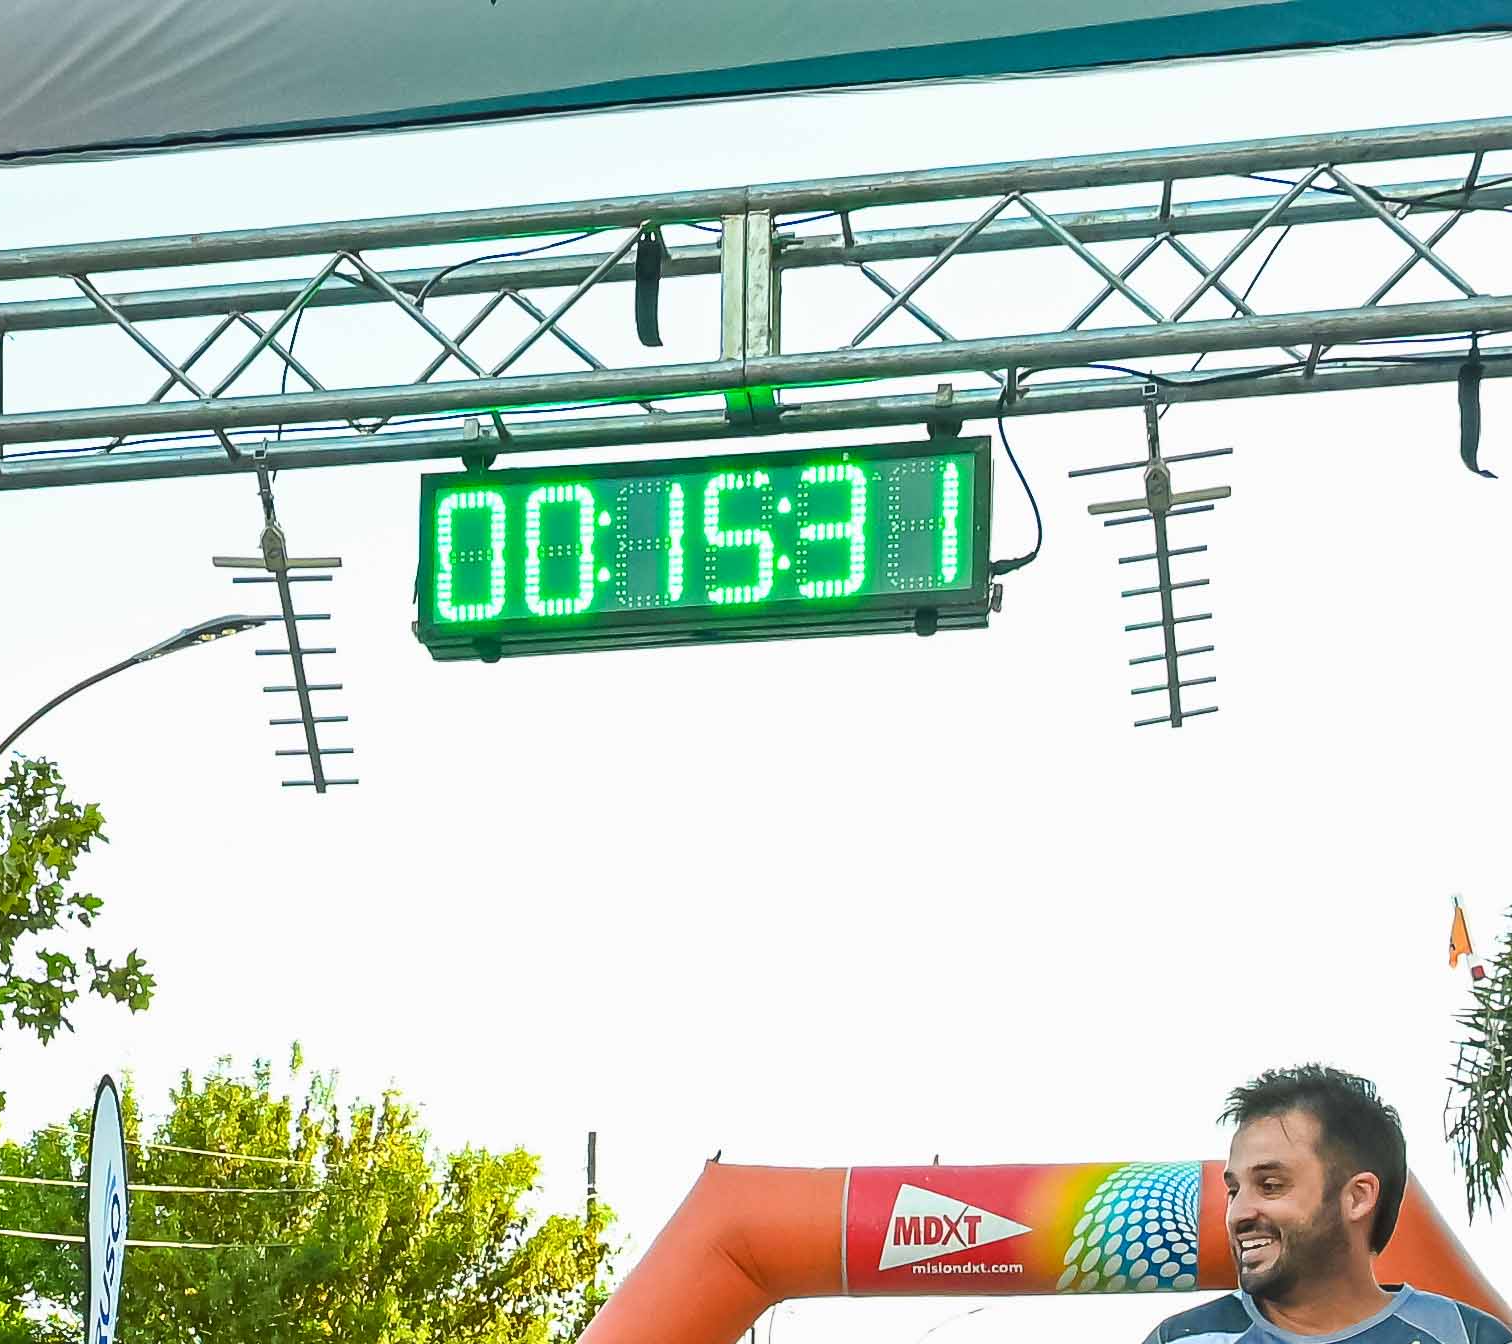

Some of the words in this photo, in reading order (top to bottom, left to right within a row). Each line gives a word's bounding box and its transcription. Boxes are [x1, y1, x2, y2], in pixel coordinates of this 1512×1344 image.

[437, 461, 958, 621] 00:15:31
[893, 1206, 982, 1248] MDXT
[912, 1262, 1024, 1275] misiondxt.com
